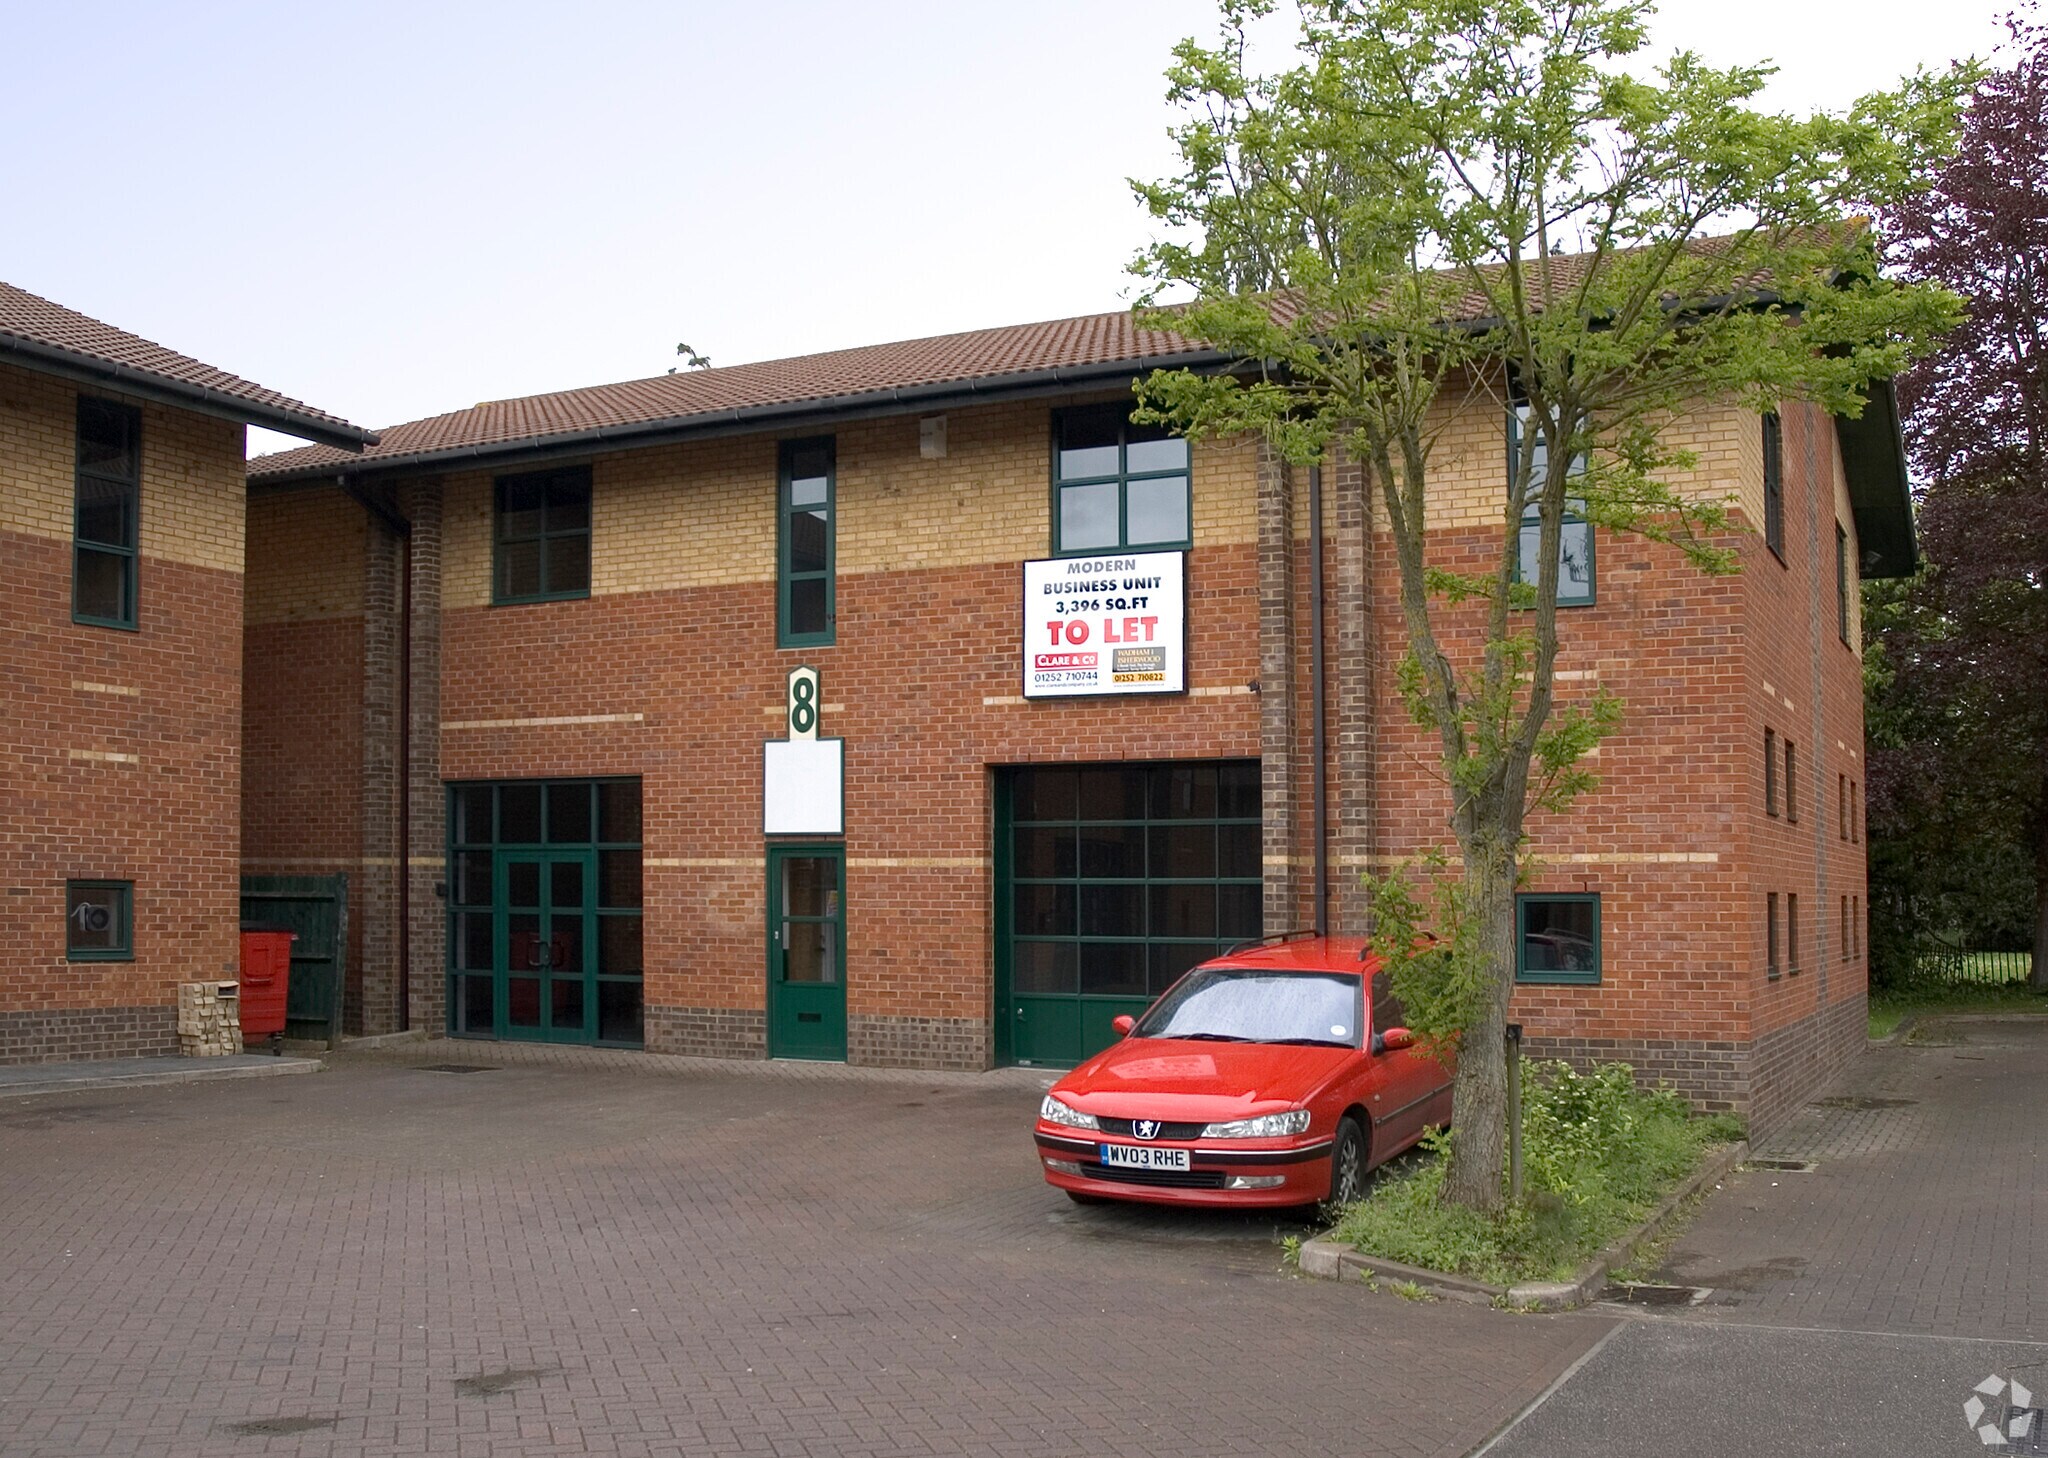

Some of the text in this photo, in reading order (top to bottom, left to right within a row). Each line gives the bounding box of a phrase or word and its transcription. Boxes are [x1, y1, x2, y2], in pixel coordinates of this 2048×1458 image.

[1067, 559, 1136, 574] MODERN
[1044, 577, 1161, 595] BUSINESS UNIT
[1056, 597, 1149, 615] 3,396 SQ.FT
[1047, 616, 1158, 645] TO LET
[1037, 655, 1070, 666] CLARE
[1072, 656, 1079, 665] &
[1035, 671, 1098, 682] 01252 710744
[1114, 674, 1135, 682] 01252
[792, 677, 815, 733] 8
[1110, 1146, 1185, 1166] WV03 RHE
